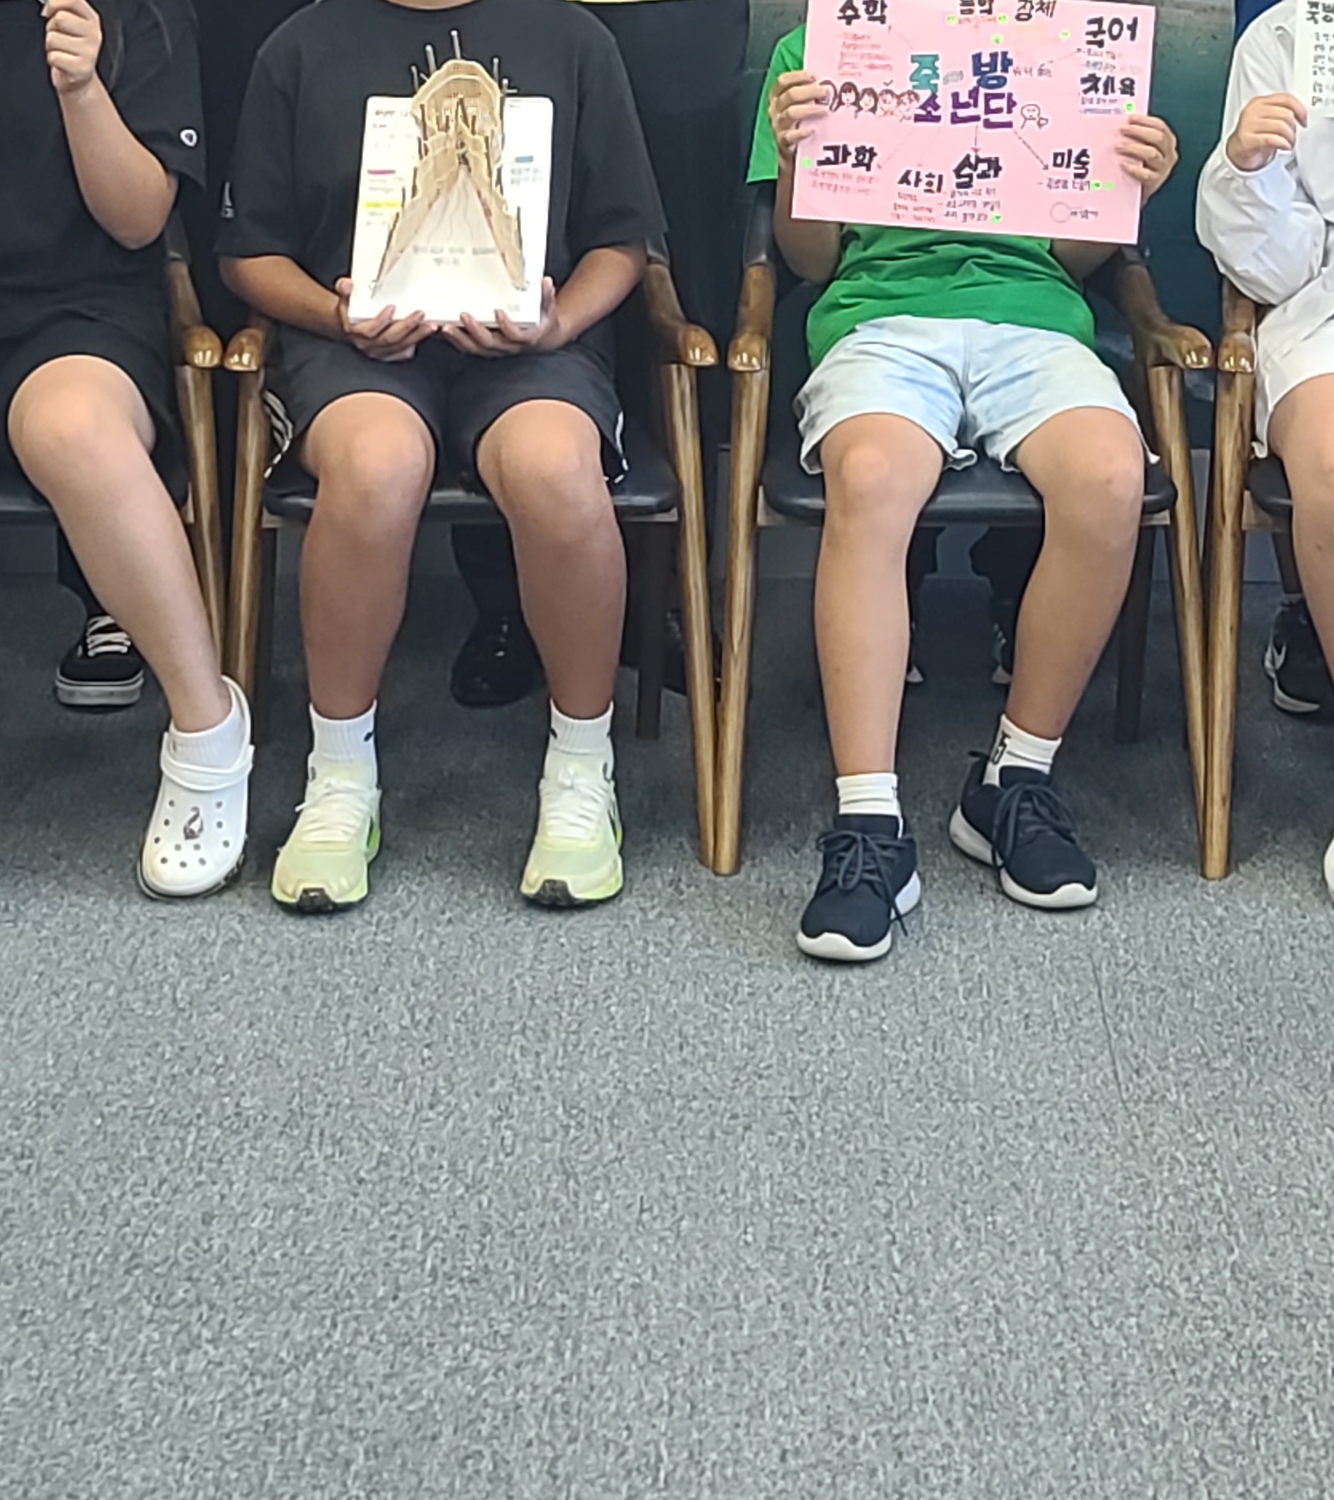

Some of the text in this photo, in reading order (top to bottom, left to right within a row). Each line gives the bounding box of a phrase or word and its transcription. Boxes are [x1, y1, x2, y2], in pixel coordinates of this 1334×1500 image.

[1084, 16, 1139, 49] 국어
[1079, 73, 1137, 97] 체육
[913, 88, 1017, 129] 소년단
[816, 144, 878, 172] 과학
[952, 153, 1003, 190] 실과
[1051, 148, 1091, 180] 미술
[896, 168, 944, 194] 사회
